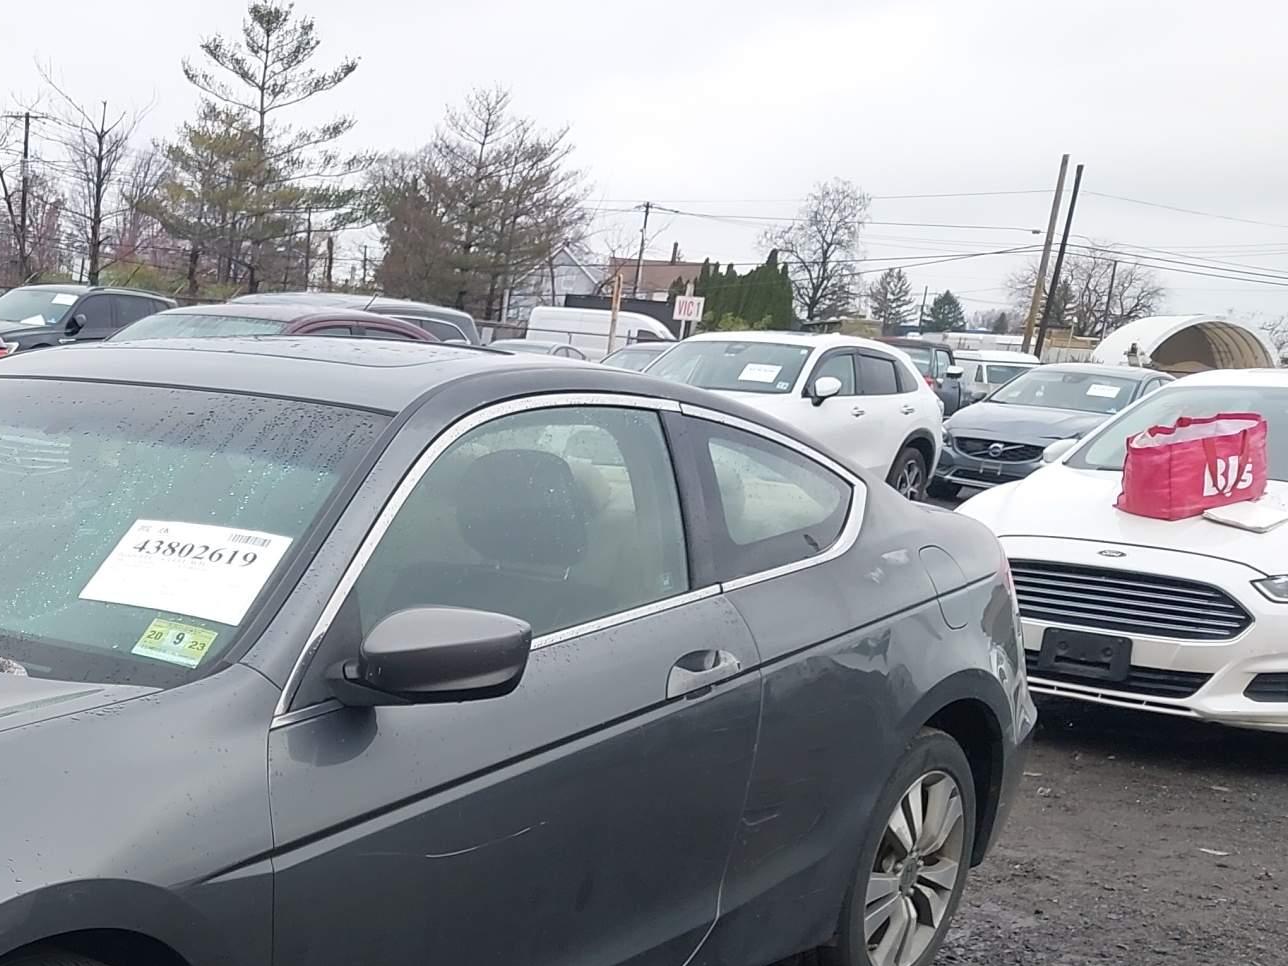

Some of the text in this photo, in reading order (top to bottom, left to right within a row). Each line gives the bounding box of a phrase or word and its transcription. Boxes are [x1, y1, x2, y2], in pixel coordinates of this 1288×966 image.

[678, 300, 694, 317] VIC
[133, 539, 258, 567] 43802619
[147, 630, 206, 652] 20 9 23
